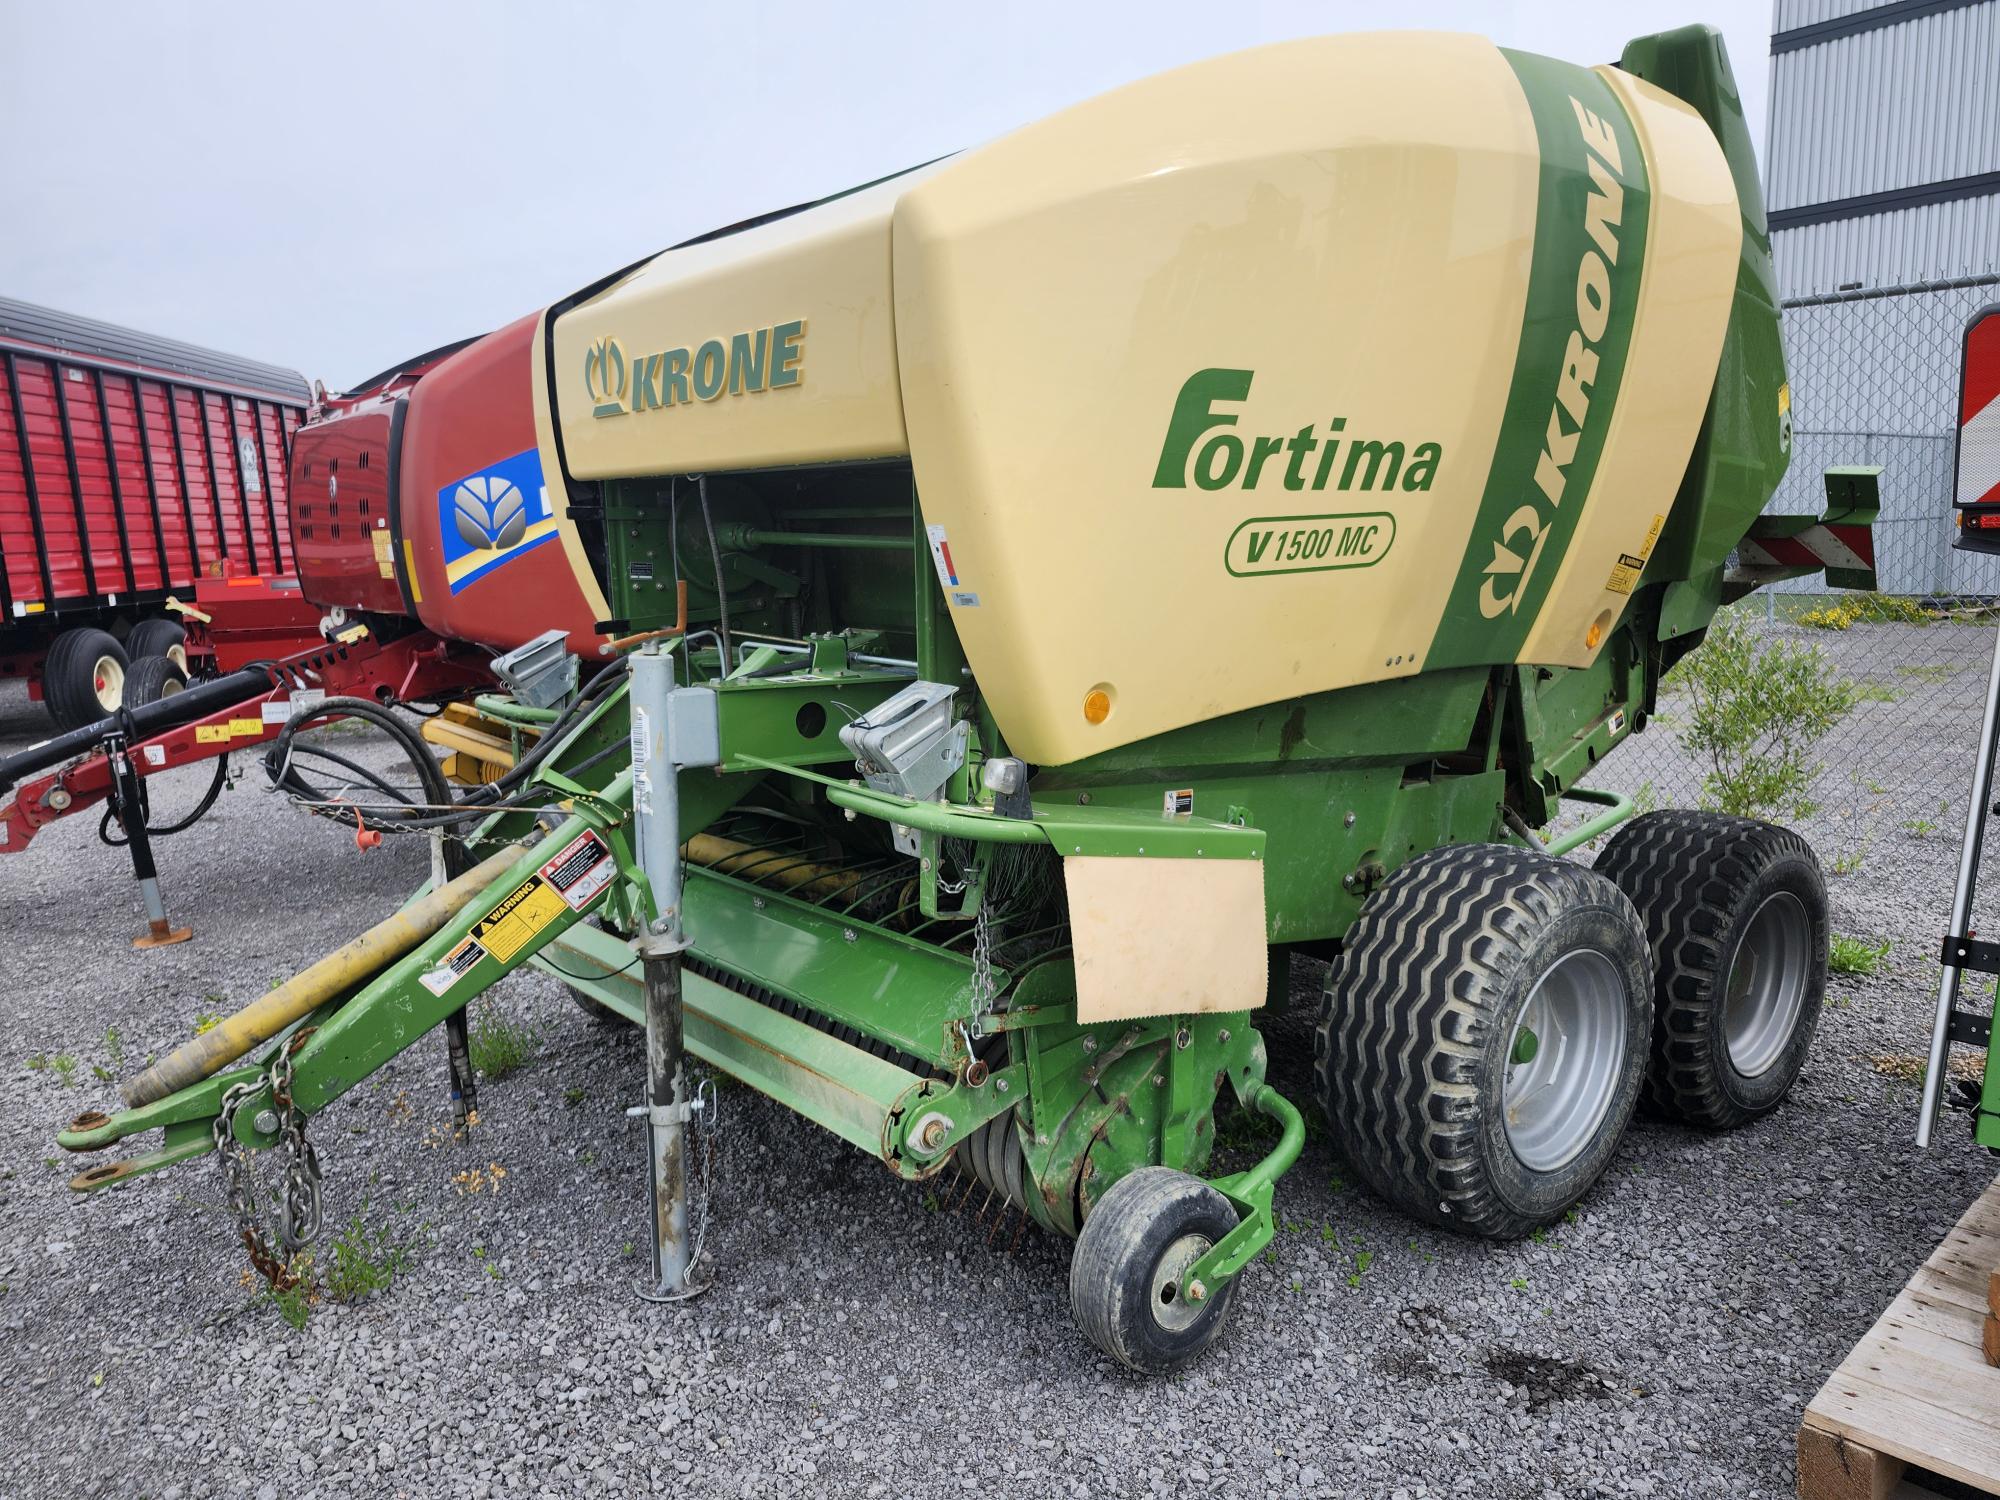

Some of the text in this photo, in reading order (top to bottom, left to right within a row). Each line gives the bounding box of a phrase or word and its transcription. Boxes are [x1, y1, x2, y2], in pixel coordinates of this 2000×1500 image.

[1533, 94, 1624, 508] KRONE
[632, 318, 806, 412] KRONE
[1152, 368, 1442, 492] Fortima
[1247, 525, 1379, 563] V 1500 MC
[555, 837, 588, 866] DANGER
[489, 882, 535, 921] WARNING
[1628, 958, 1648, 1009] BKT
